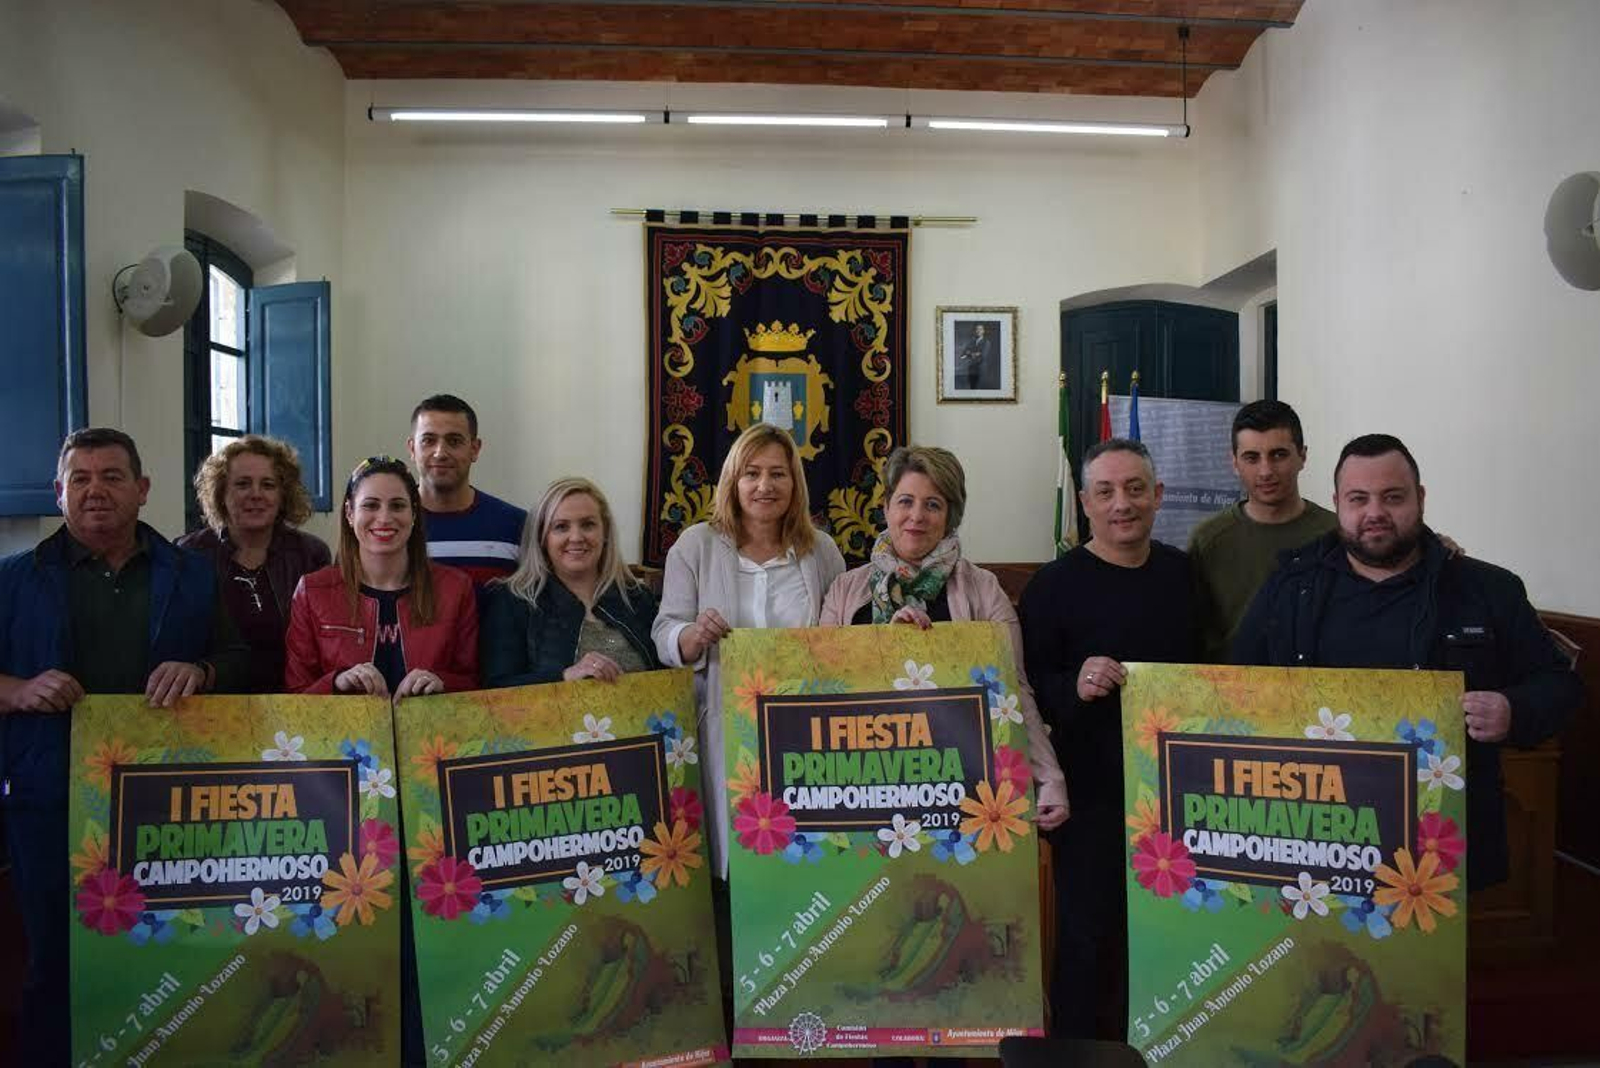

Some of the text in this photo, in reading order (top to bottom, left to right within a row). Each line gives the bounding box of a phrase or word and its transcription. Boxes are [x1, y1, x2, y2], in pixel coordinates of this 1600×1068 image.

[810, 712, 934, 751] I FIESTA
[493, 763, 613, 809] I FIESTA
[782, 746, 965, 786] PRIMAVERA
[1213, 758, 1347, 804] I FIESTA
[170, 783, 299, 823] I FIESTA
[782, 782, 966, 812] CAMPOHERMOSO
[1183, 793, 1382, 846] PRIMAVERA
[135, 818, 330, 861] PRIMAVERA
[466, 793, 644, 848] PRIMAVERA
[920, 813, 961, 829] 2019
[467, 824, 645, 870] CAMPOHERMOSO
[603, 853, 642, 873] 2019
[1182, 828, 1382, 873] CAMPOHERMOSO
[132, 854, 329, 887] CAMPOHERMOSO
[1330, 875, 1376, 895] 2019
[281, 886, 323, 902] 2019
[740, 975, 757, 993] 5
[758, 949, 775, 967] 6
[781, 931, 797, 949] 7
[793, 891, 831, 935] abril
[753, 876, 891, 1017] Plaza Juan Antonio Lozano
[483, 947, 522, 995] abril
[501, 966, 544, 1019] Antonio
[537, 922, 579, 967] Lozano
[1134, 1016, 1151, 1038] 5
[1154, 994, 1170, 1015] 6
[1176, 980, 1193, 1000] 7
[1189, 941, 1231, 987] abril
[139, 971, 182, 1017] abril
[155, 994, 206, 1039] Antonio
[199, 953, 247, 996] Lozano
[1145, 1033, 1183, 1064] Plaza
[1203, 972, 1253, 1018] Antonio
[1247, 936, 1295, 977] Lozano
